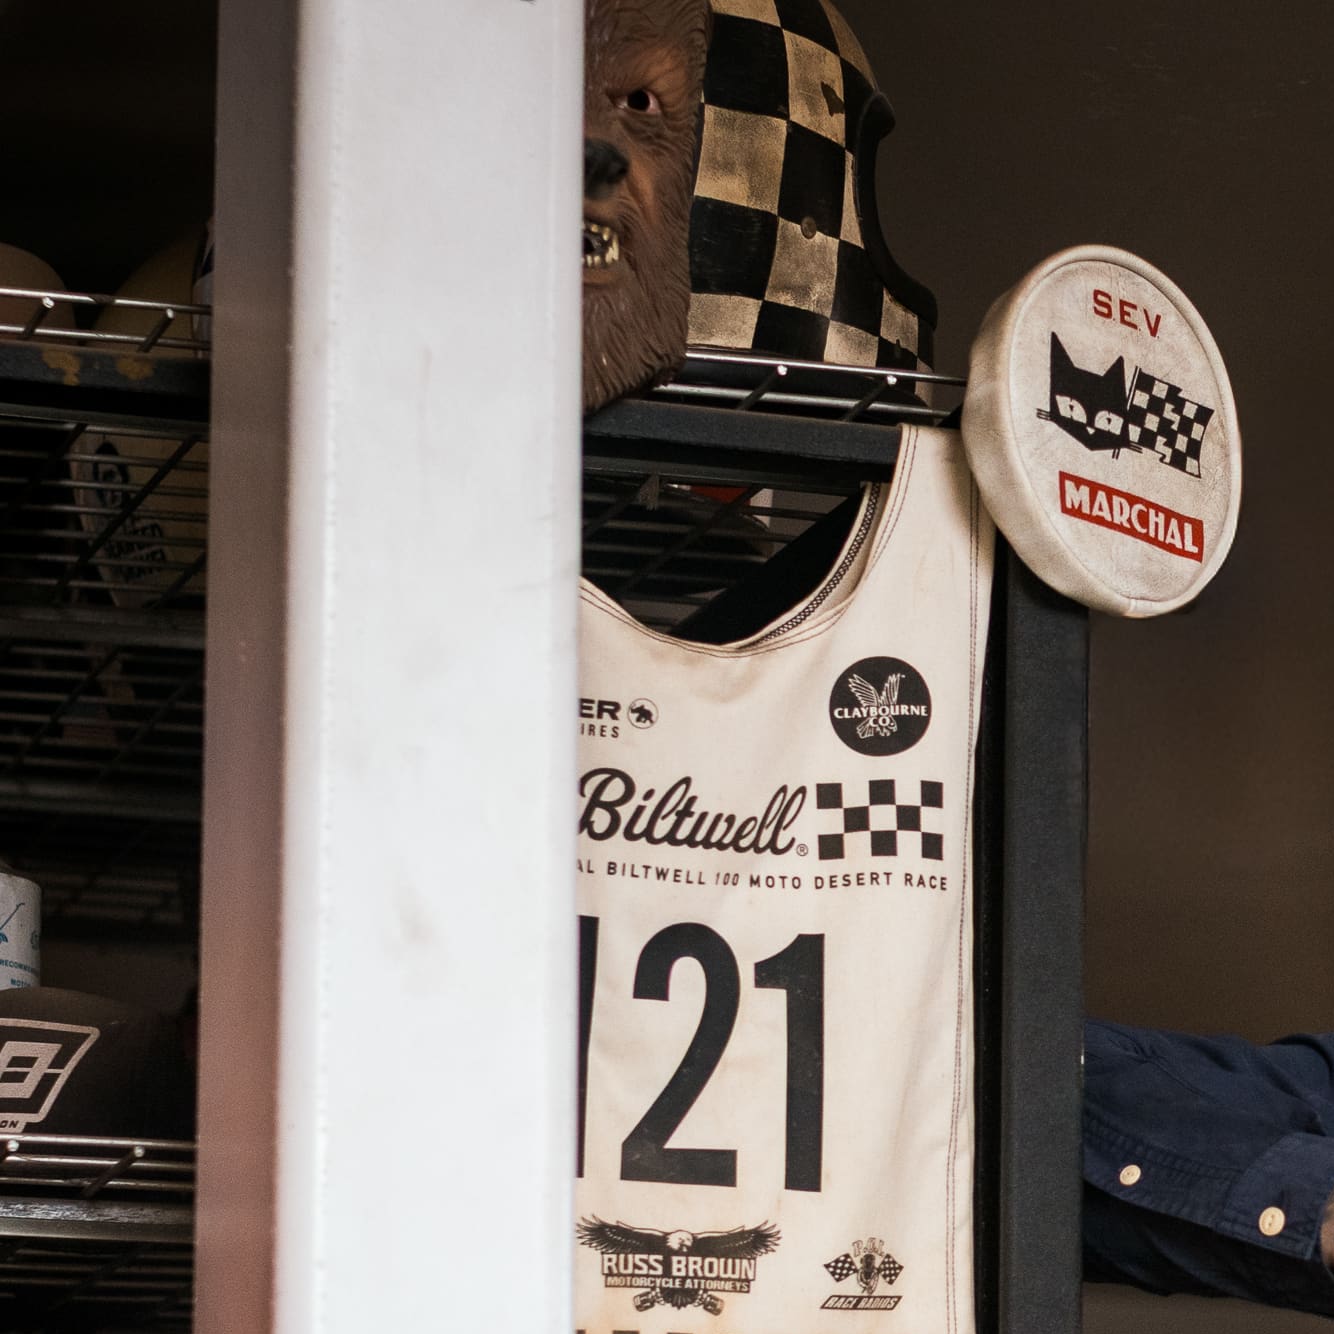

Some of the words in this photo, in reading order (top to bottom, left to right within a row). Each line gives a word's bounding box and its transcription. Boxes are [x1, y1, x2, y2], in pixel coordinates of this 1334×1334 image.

[1063, 480, 1200, 554] MARCHAL
[833, 704, 929, 719] CLAYBOURNE
[869, 716, 896, 728] CO.
[579, 767, 808, 857] Biltwell
[607, 861, 707, 886] BILTWELL
[714, 871, 741, 887] 100
[749, 875, 803, 891] MOTO
[814, 871, 893, 891] DESERT
[904, 872, 950, 892] RACE
[602, 1254, 664, 1275] RUSS
[671, 1255, 756, 1280] BROWN
[606, 1275, 682, 1289] MOTORCYCLE
[684, 1278, 749, 1292] ATTORNEYS
